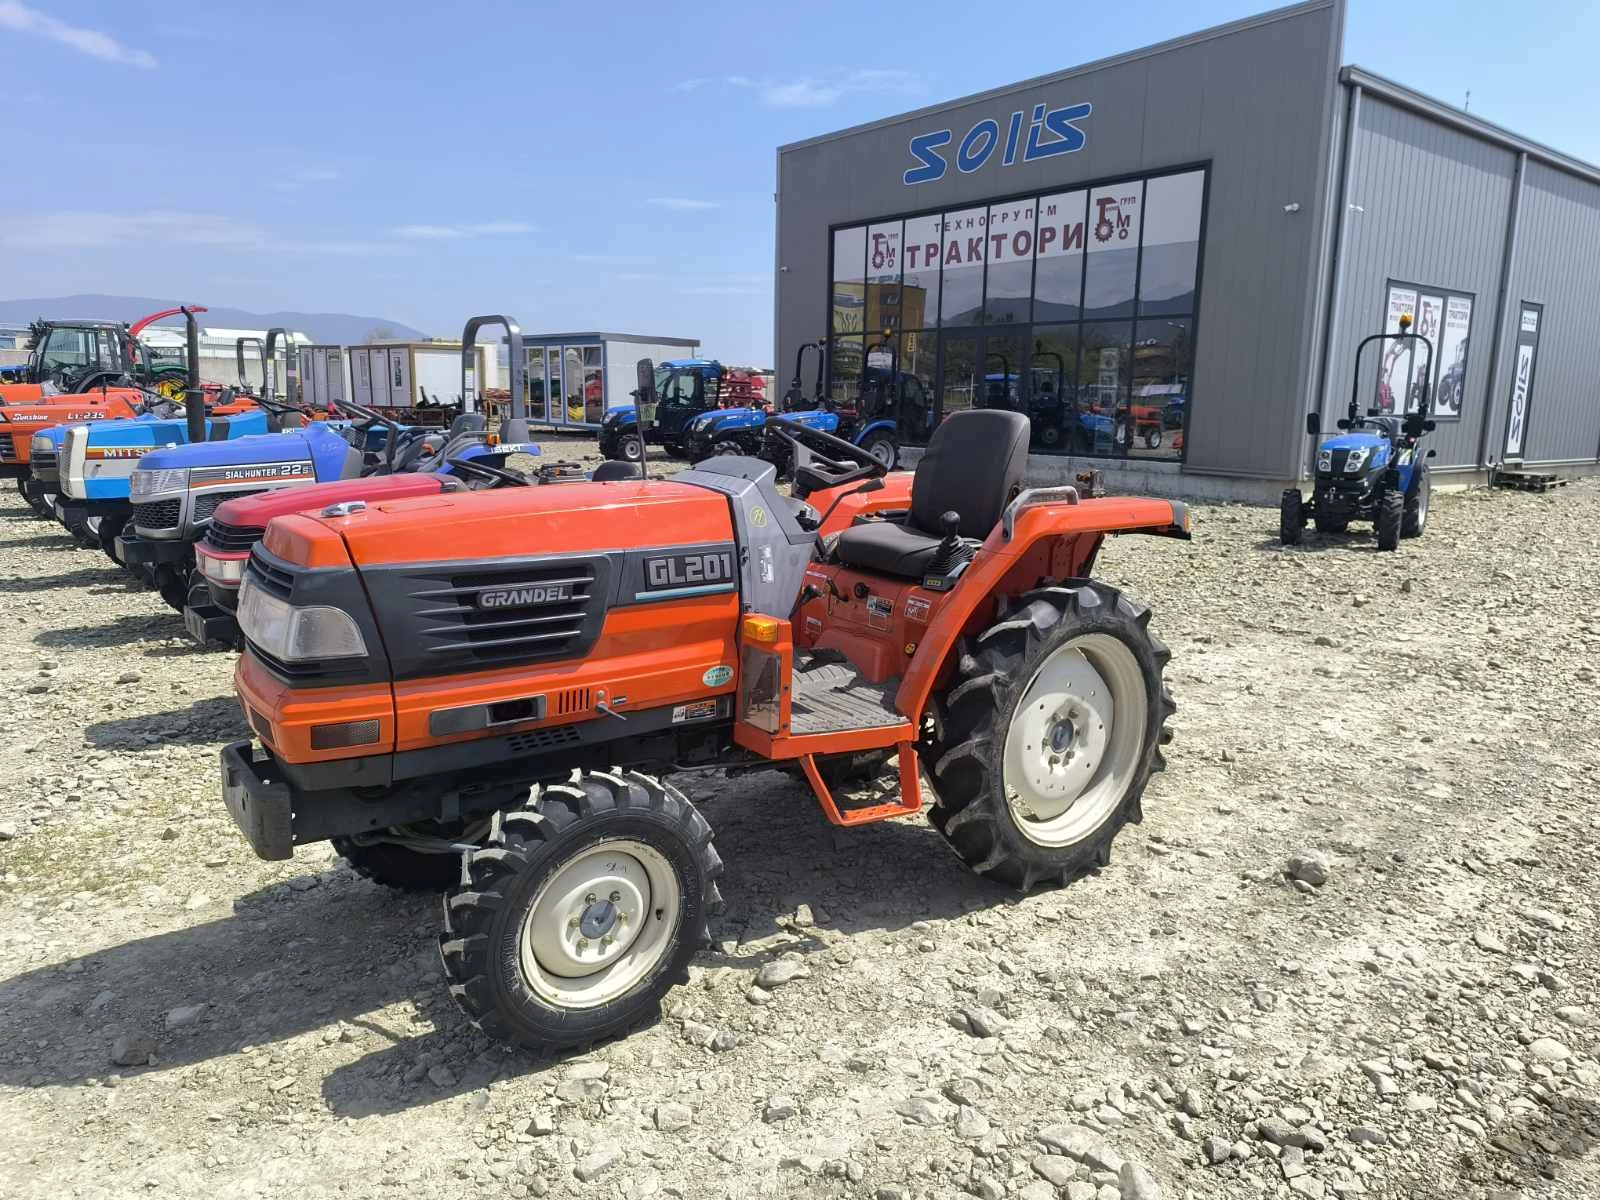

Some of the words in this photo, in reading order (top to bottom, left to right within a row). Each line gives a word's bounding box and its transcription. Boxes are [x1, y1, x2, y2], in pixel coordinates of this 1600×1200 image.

[906, 222, 1083, 269] ТРАКТОРИ
[12, 413, 48, 421] Sunshine
[103, 447, 151, 457] MITS
[649, 554, 731, 586] GL201
[481, 587, 569, 608] GRANDEL
